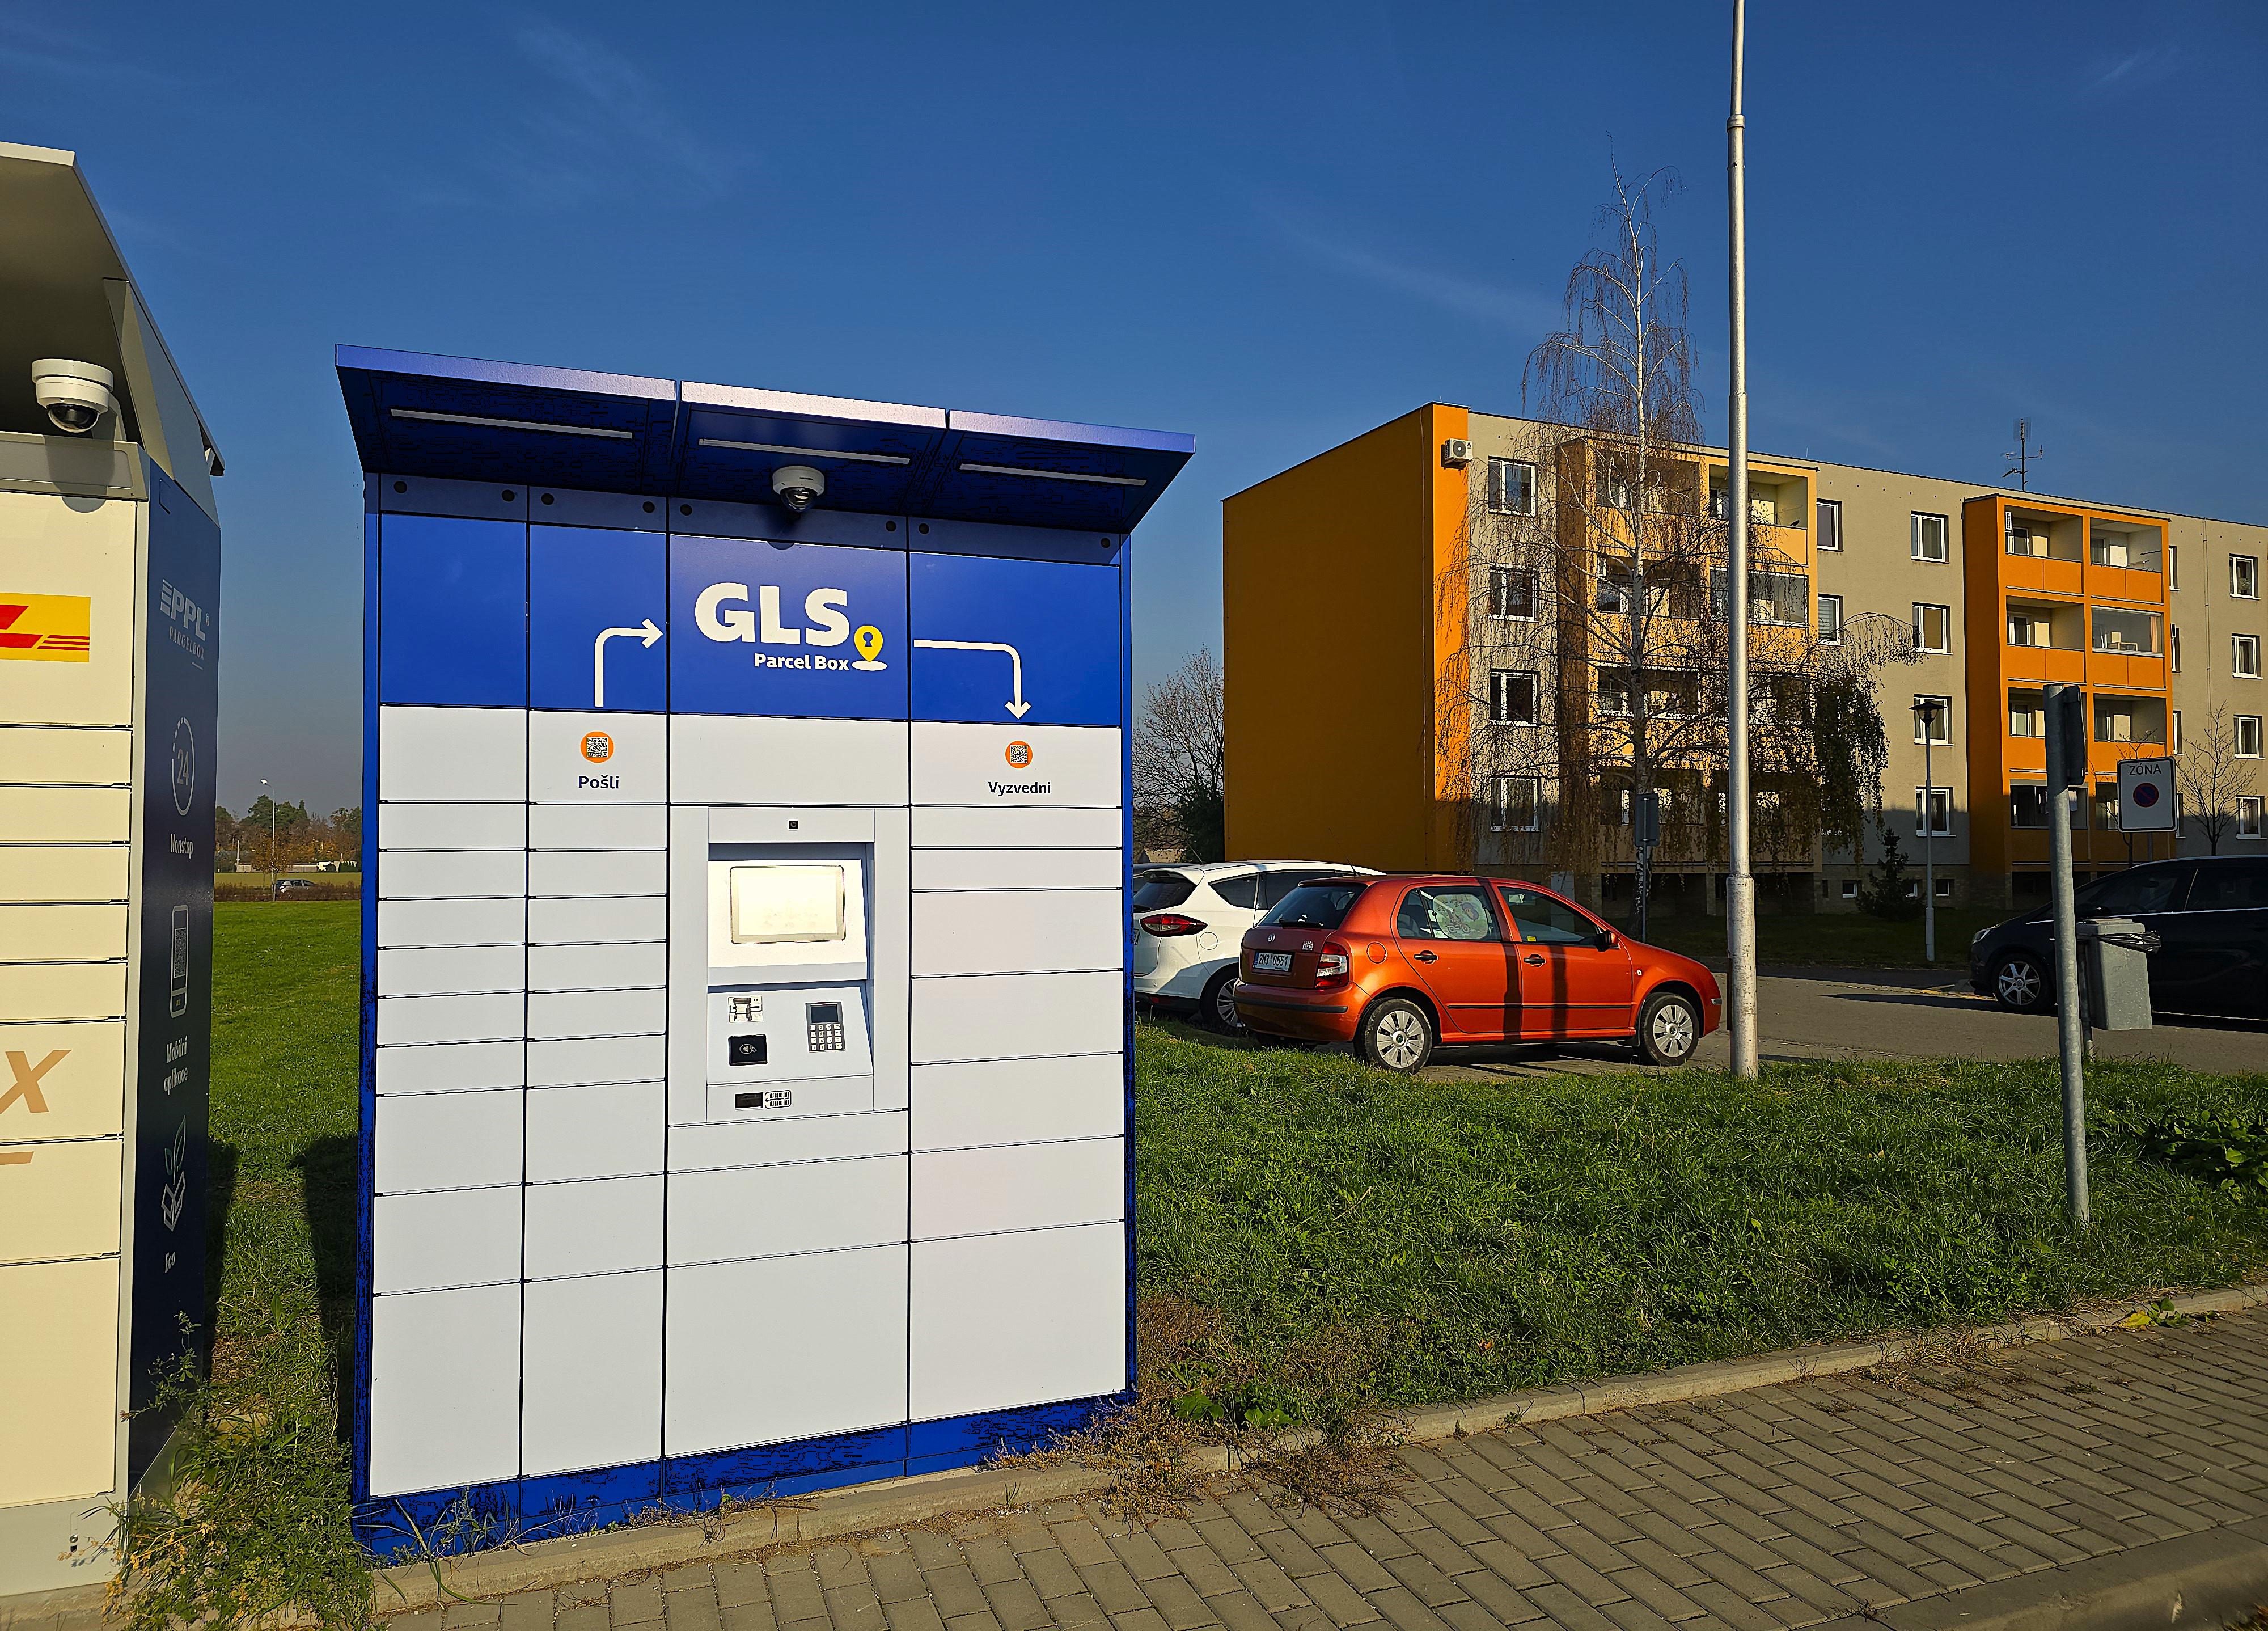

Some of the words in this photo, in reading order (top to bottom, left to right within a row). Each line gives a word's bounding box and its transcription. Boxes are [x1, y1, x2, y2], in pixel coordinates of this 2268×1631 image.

[695, 582, 850, 647] GLS
[169, 626, 205, 660] PARCELBOX
[754, 653, 811, 669] Parcel
[815, 656, 849, 671] Box
[177, 749, 189, 785] 24
[2129, 763, 2162, 776] ZÓNA
[578, 775, 619, 789] Pošli
[988, 781, 1051, 797] Vyzvedni
[170, 834, 193, 859] Nonstop
[1272, 955, 1288, 967] 0551
[166, 1035, 188, 1063] Mobilní
[164, 1067, 188, 1096] aplikace
[165, 1252, 176, 1273] Eco
